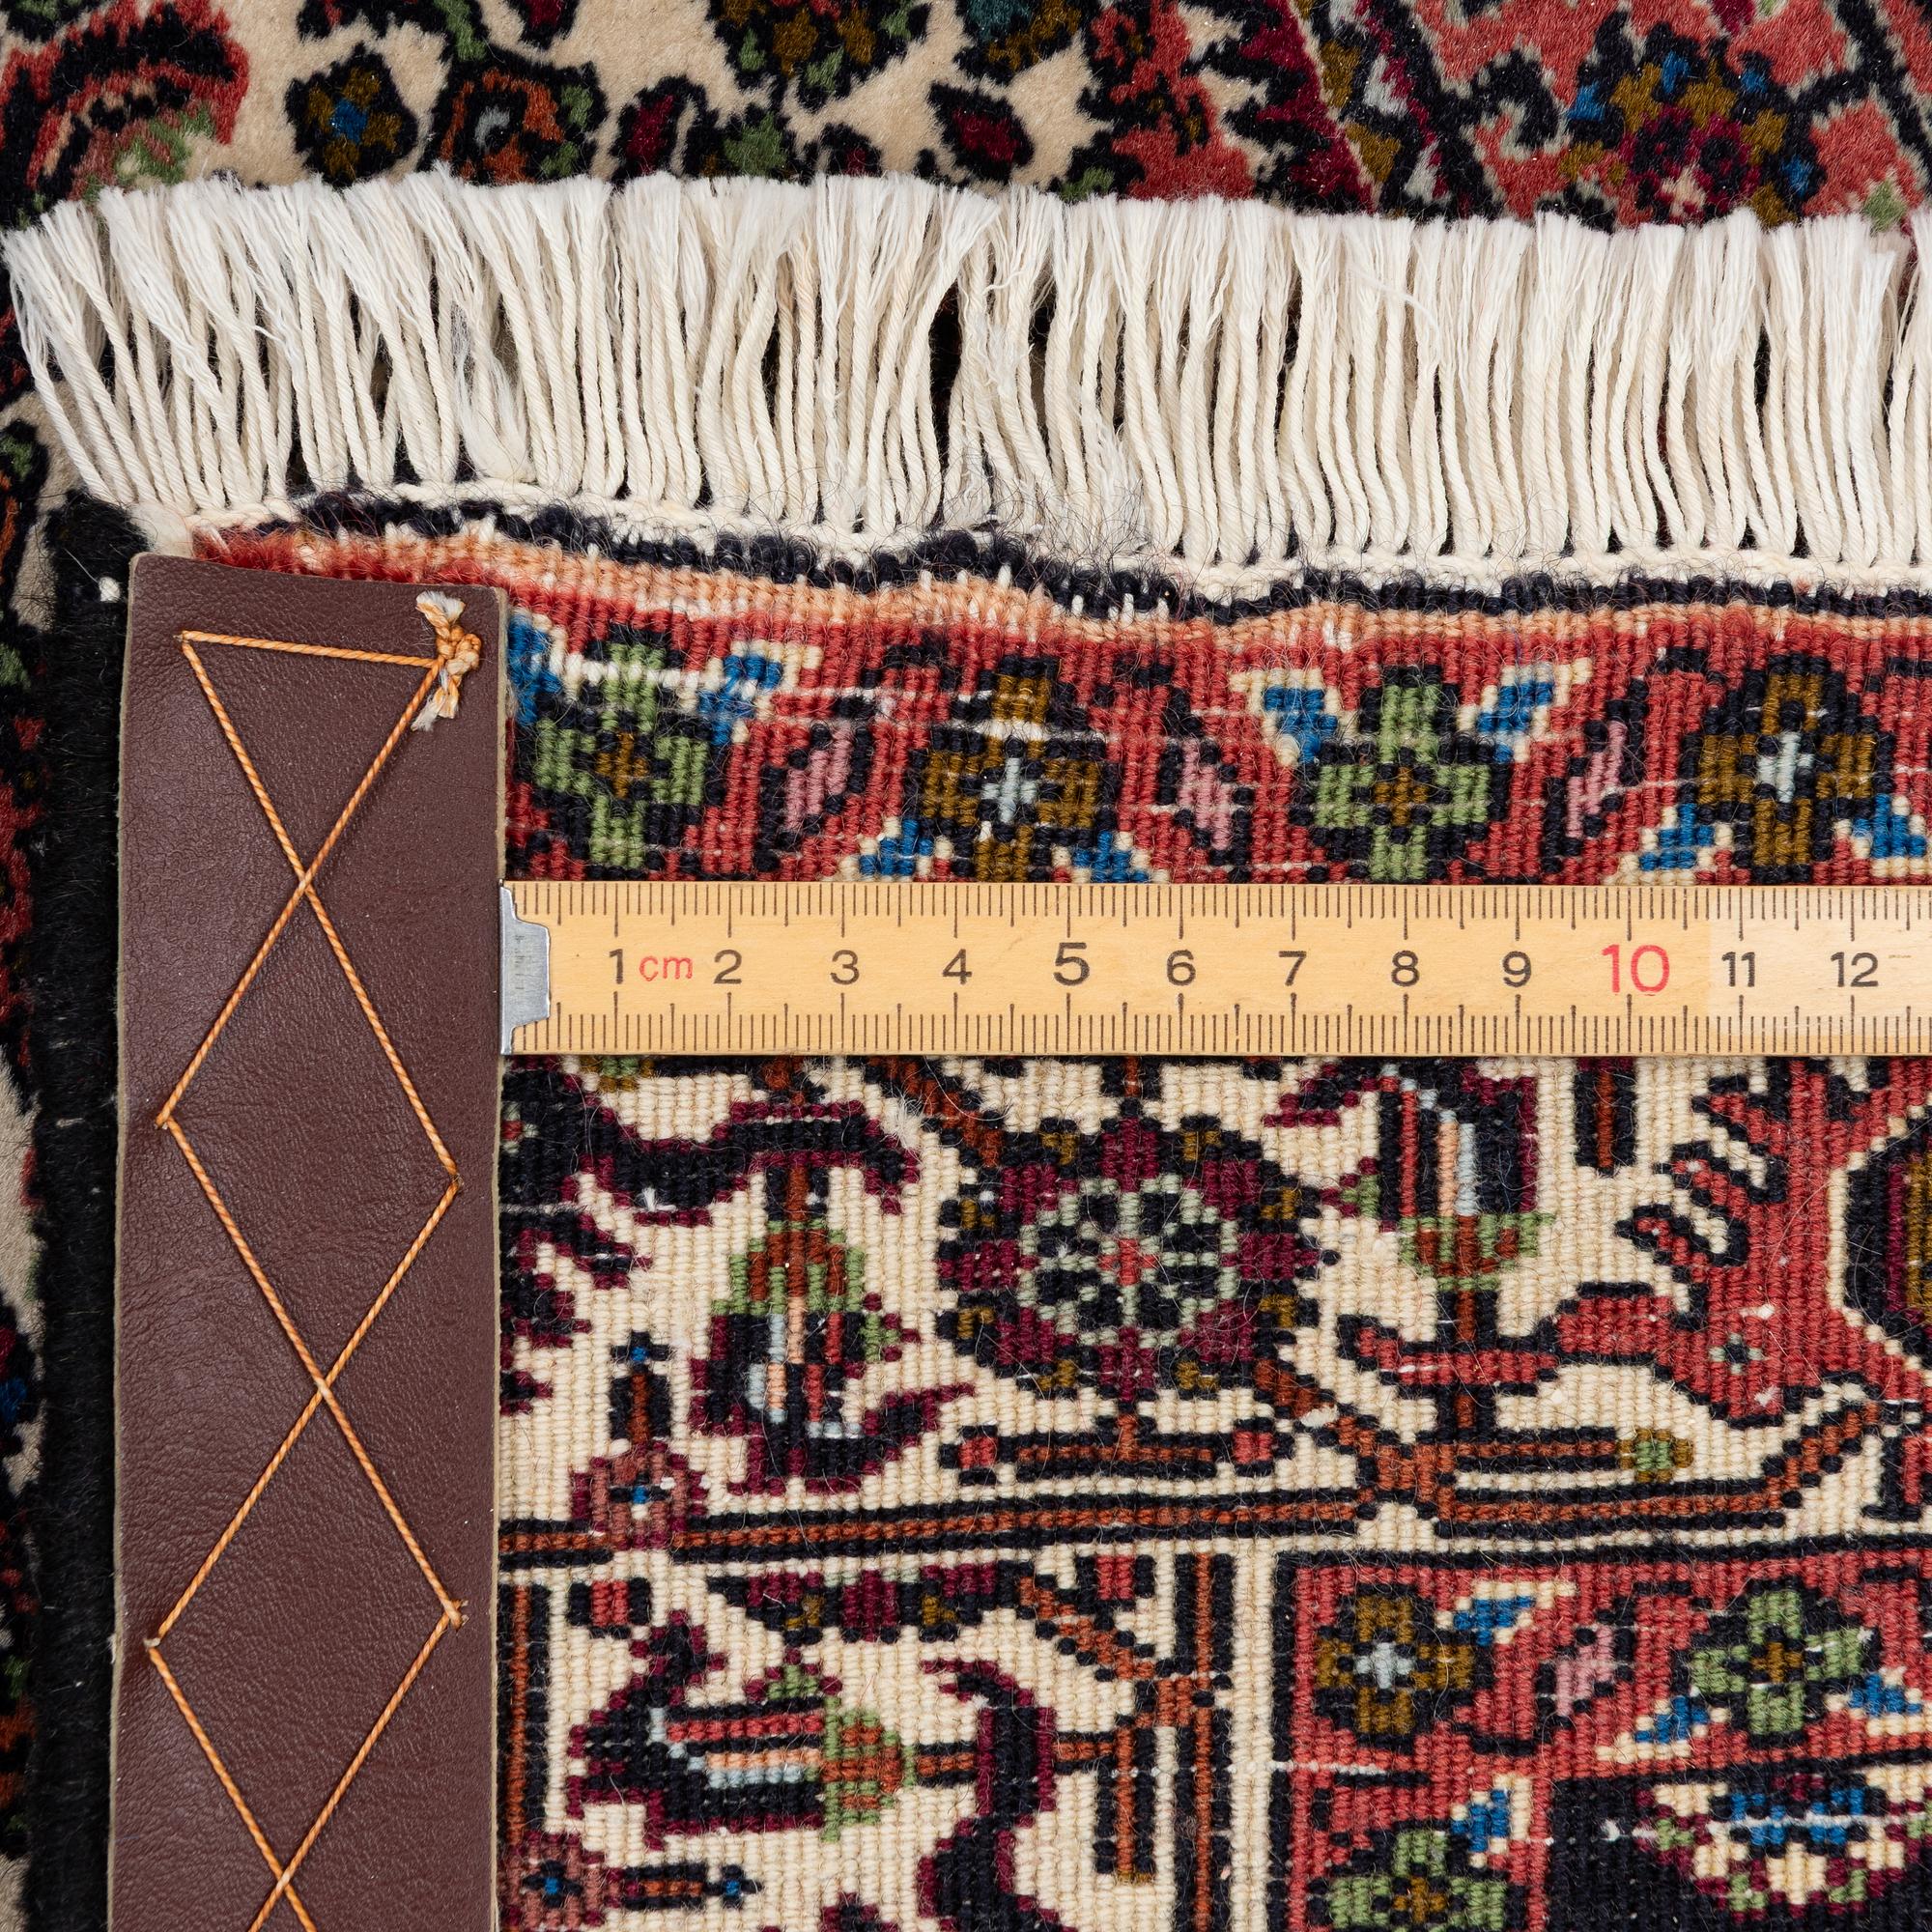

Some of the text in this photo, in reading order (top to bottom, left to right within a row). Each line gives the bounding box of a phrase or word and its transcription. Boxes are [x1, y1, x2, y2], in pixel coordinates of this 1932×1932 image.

[609, 941, 1880, 995] 1 cm 2 3 4 5 6 7 8 9 10 11 12
